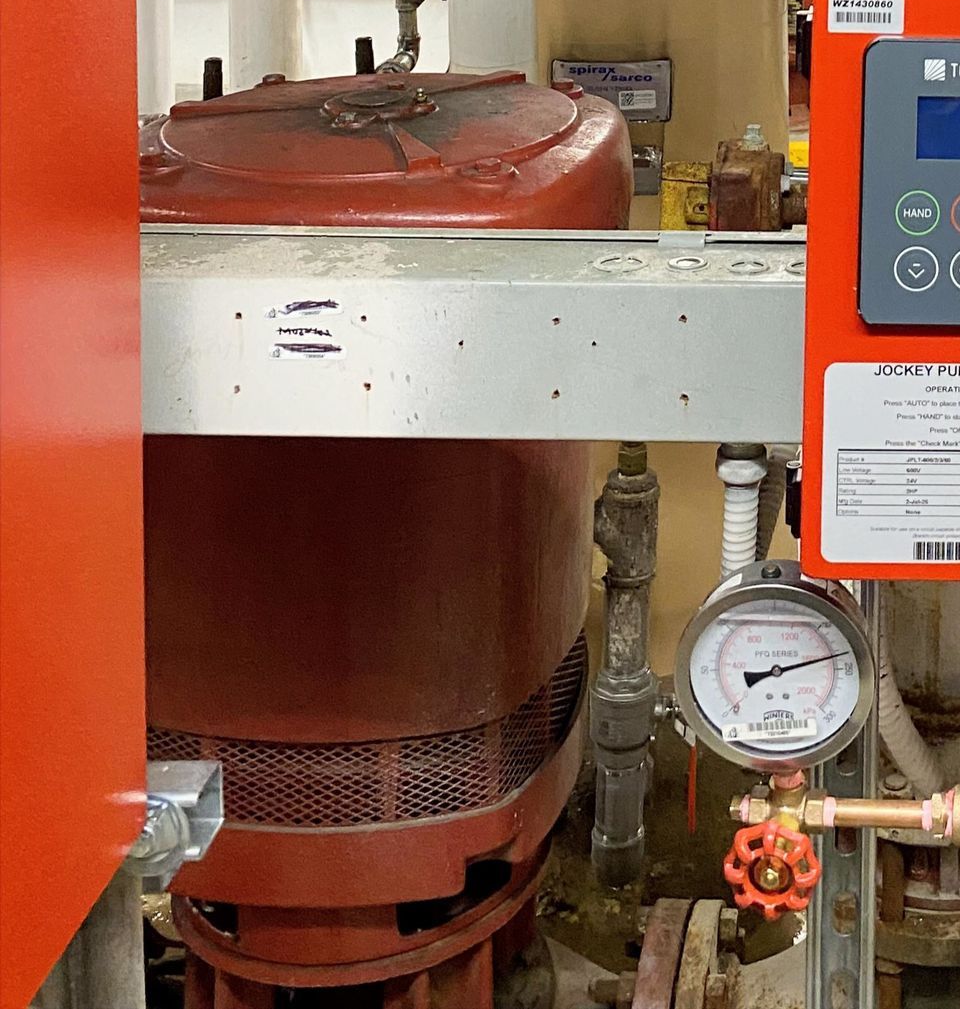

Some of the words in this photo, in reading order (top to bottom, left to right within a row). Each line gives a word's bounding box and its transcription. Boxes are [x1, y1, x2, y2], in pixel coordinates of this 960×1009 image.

[832, 0, 893, 8] WZ1430860
[568, 64, 616, 75] spirax
[610, 74, 653, 82] sarco
[903, 208, 932, 218] HAND
[874, 364, 934, 376] JOCKEY
[939, 400, 957, 408] place
[781, 632, 799, 642] 1200
[754, 650, 770, 658] PFQ
[771, 650, 799, 658] SERIES
[797, 686, 816, 695] 2000
